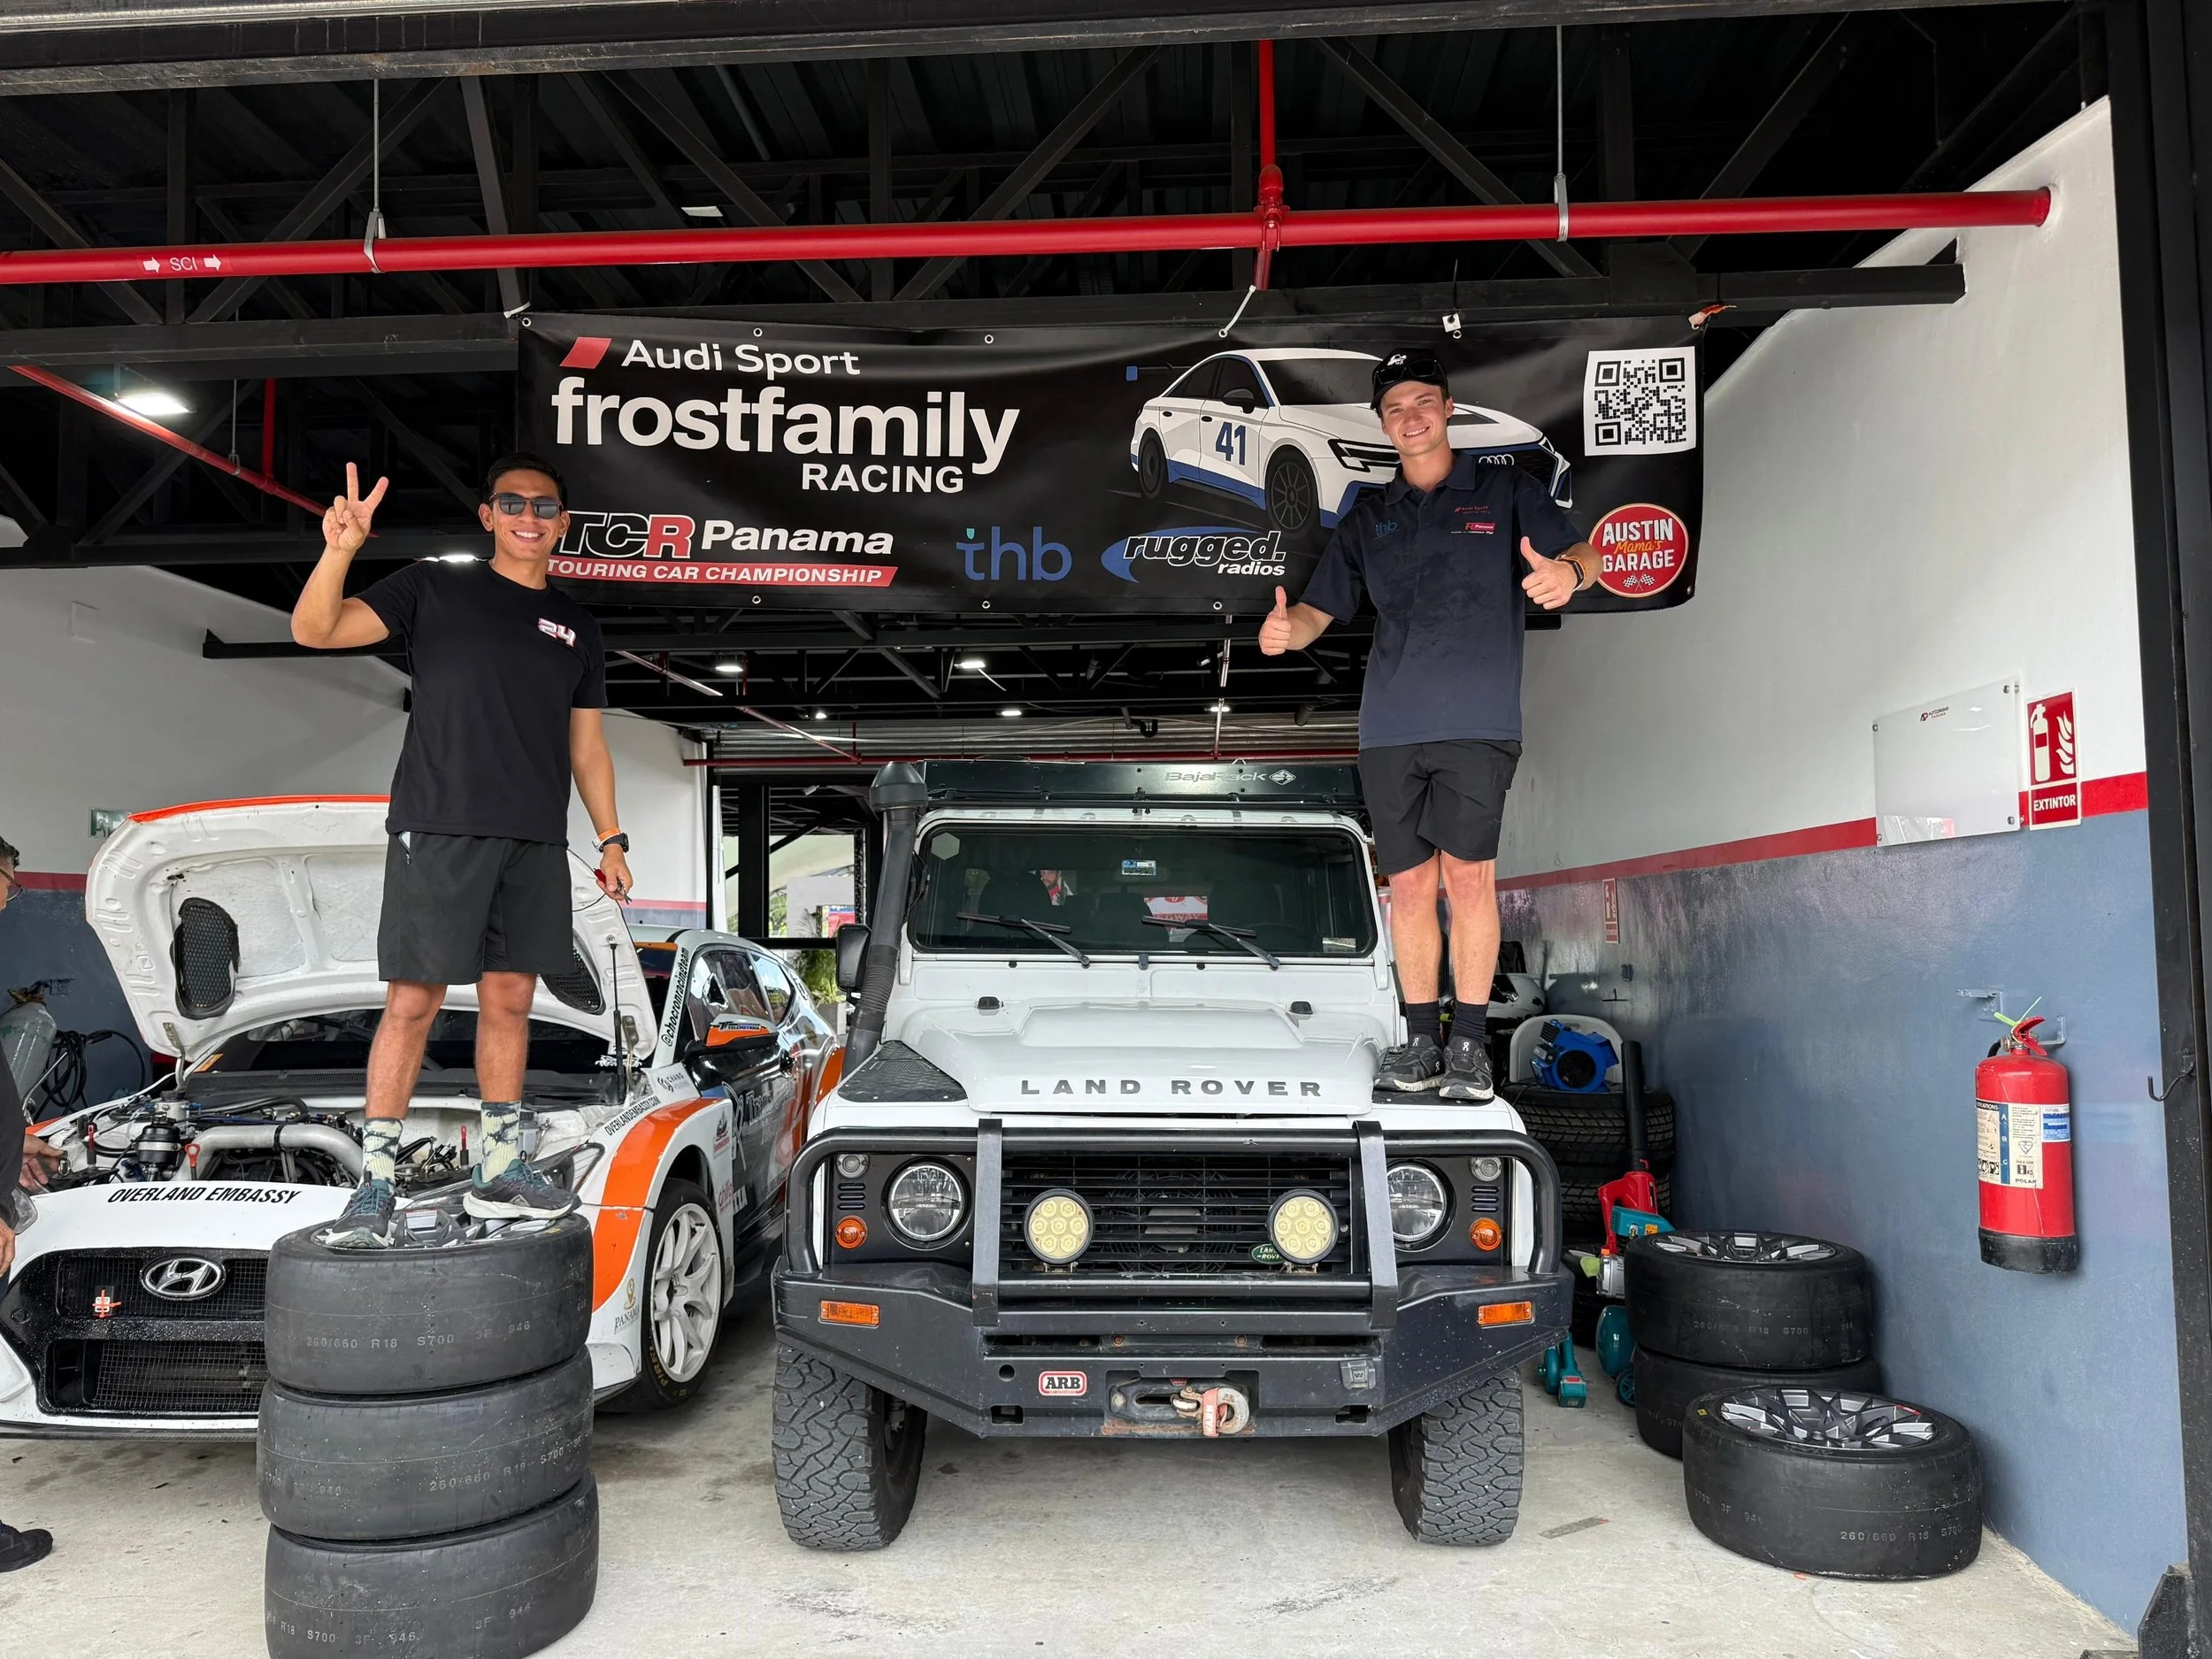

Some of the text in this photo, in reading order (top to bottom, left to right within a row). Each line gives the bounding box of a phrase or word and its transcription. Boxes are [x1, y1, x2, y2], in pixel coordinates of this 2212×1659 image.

[169, 257, 198, 271] SCI
[621, 339, 860, 380] Audi Sport
[551, 377, 1020, 475] frostfamily
[1215, 421, 1246, 466] 41
[801, 463, 964, 494] RACING
[559, 511, 894, 559] TCR Panama
[1601, 518, 1674, 547] AUSTIN
[956, 526, 1073, 582] thb
[1614, 540, 1663, 554] Mama's
[547, 559, 882, 583] TOURING CAR CHAMPIONSHIP
[1217, 562, 1286, 576] radios
[1602, 549, 1675, 572] GARAGE
[538, 618, 576, 647] 24
[1164, 772, 1267, 782] BajaRack
[2033, 794, 2076, 810] EXTINTOR
[661, 947, 689, 1047] @chocronracingteam
[1021, 1080, 1322, 1096] LAND ROVER
[107, 1187, 302, 1204] OVERLAND EMBASSY
[371, 1339, 398, 1349] R18
[417, 1334, 455, 1347] S700
[1045, 1377, 1081, 1389] ARB
[430, 1471, 492, 1492] 260/660
[540, 1447, 565, 1464] S700
[1839, 1530, 1898, 1543] 260/660
[1908, 1531, 1931, 1542] R18
[306, 1630, 337, 1643] S700
